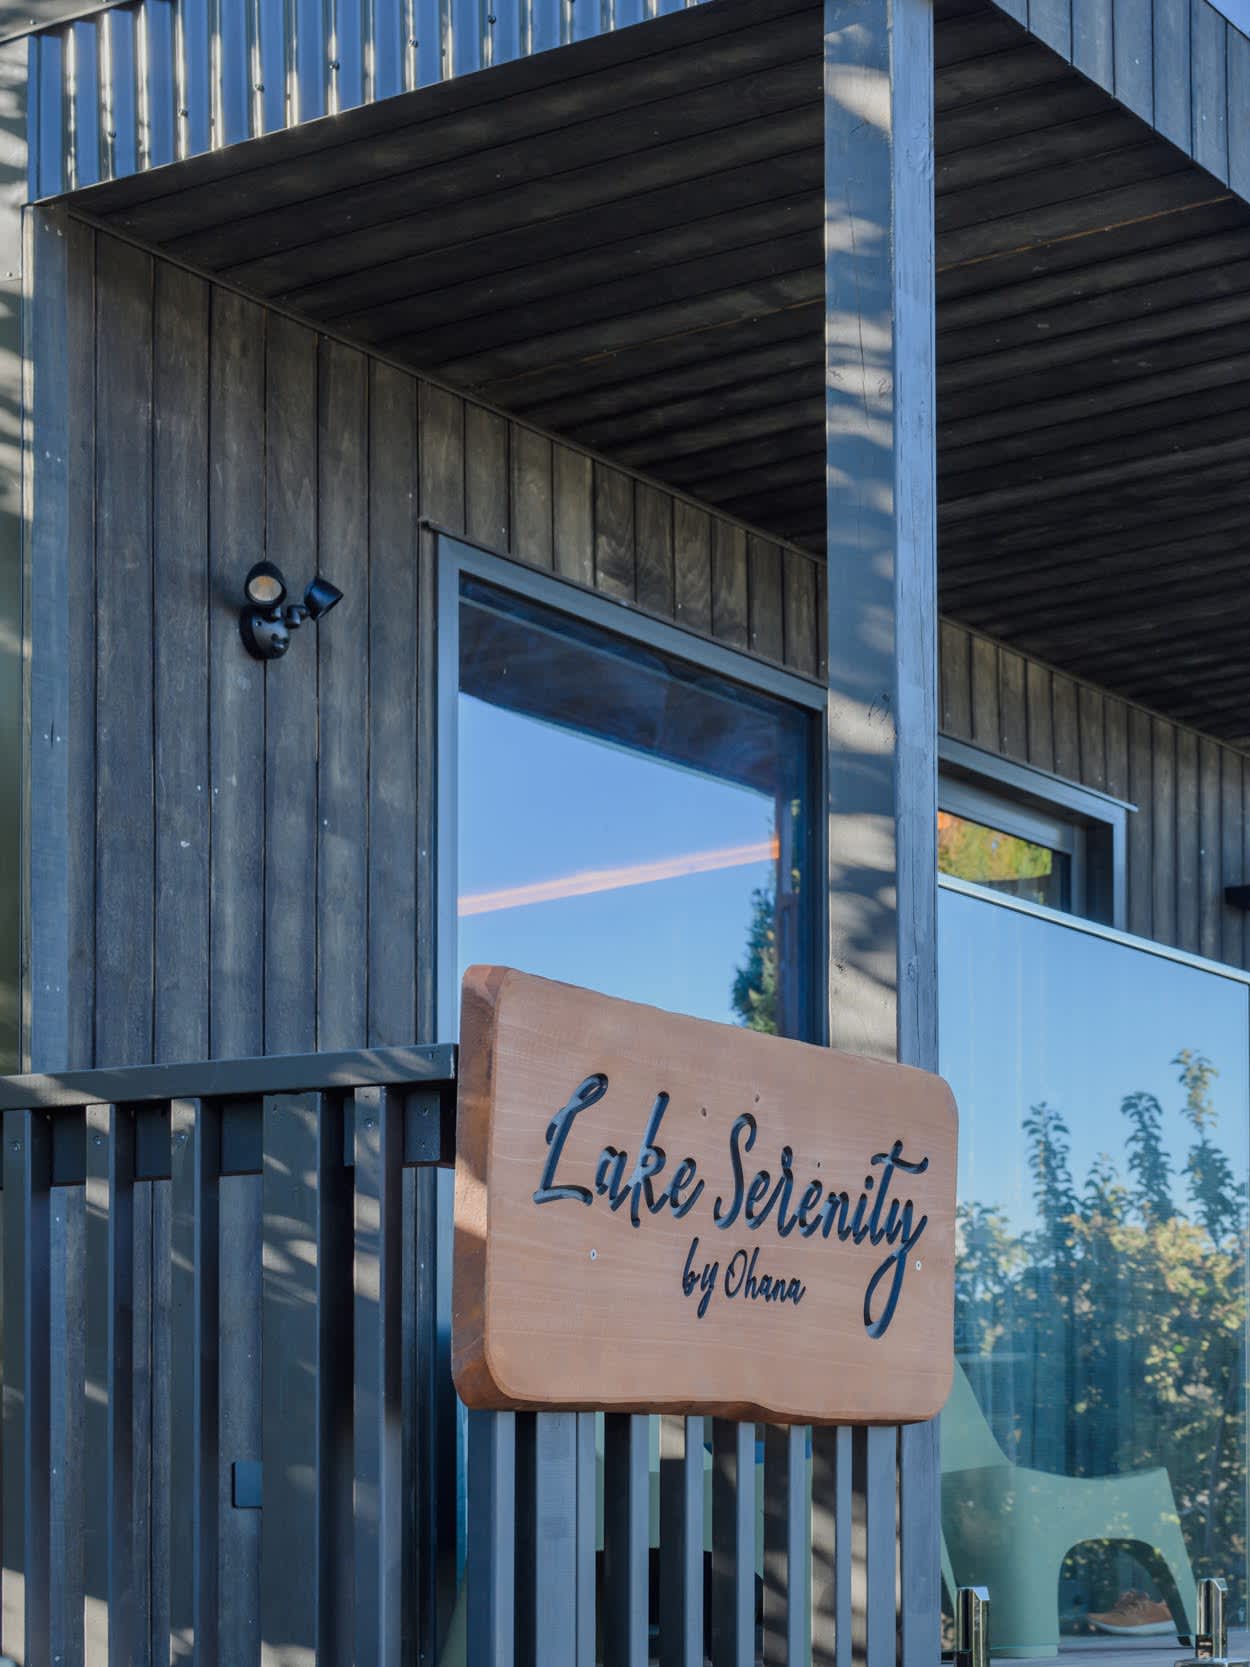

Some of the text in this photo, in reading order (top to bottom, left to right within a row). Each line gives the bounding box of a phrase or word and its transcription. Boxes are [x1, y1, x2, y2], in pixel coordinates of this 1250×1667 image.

[533, 1073, 929, 1339] Lake Serenity
[682, 1237, 806, 1319] by Ohana
